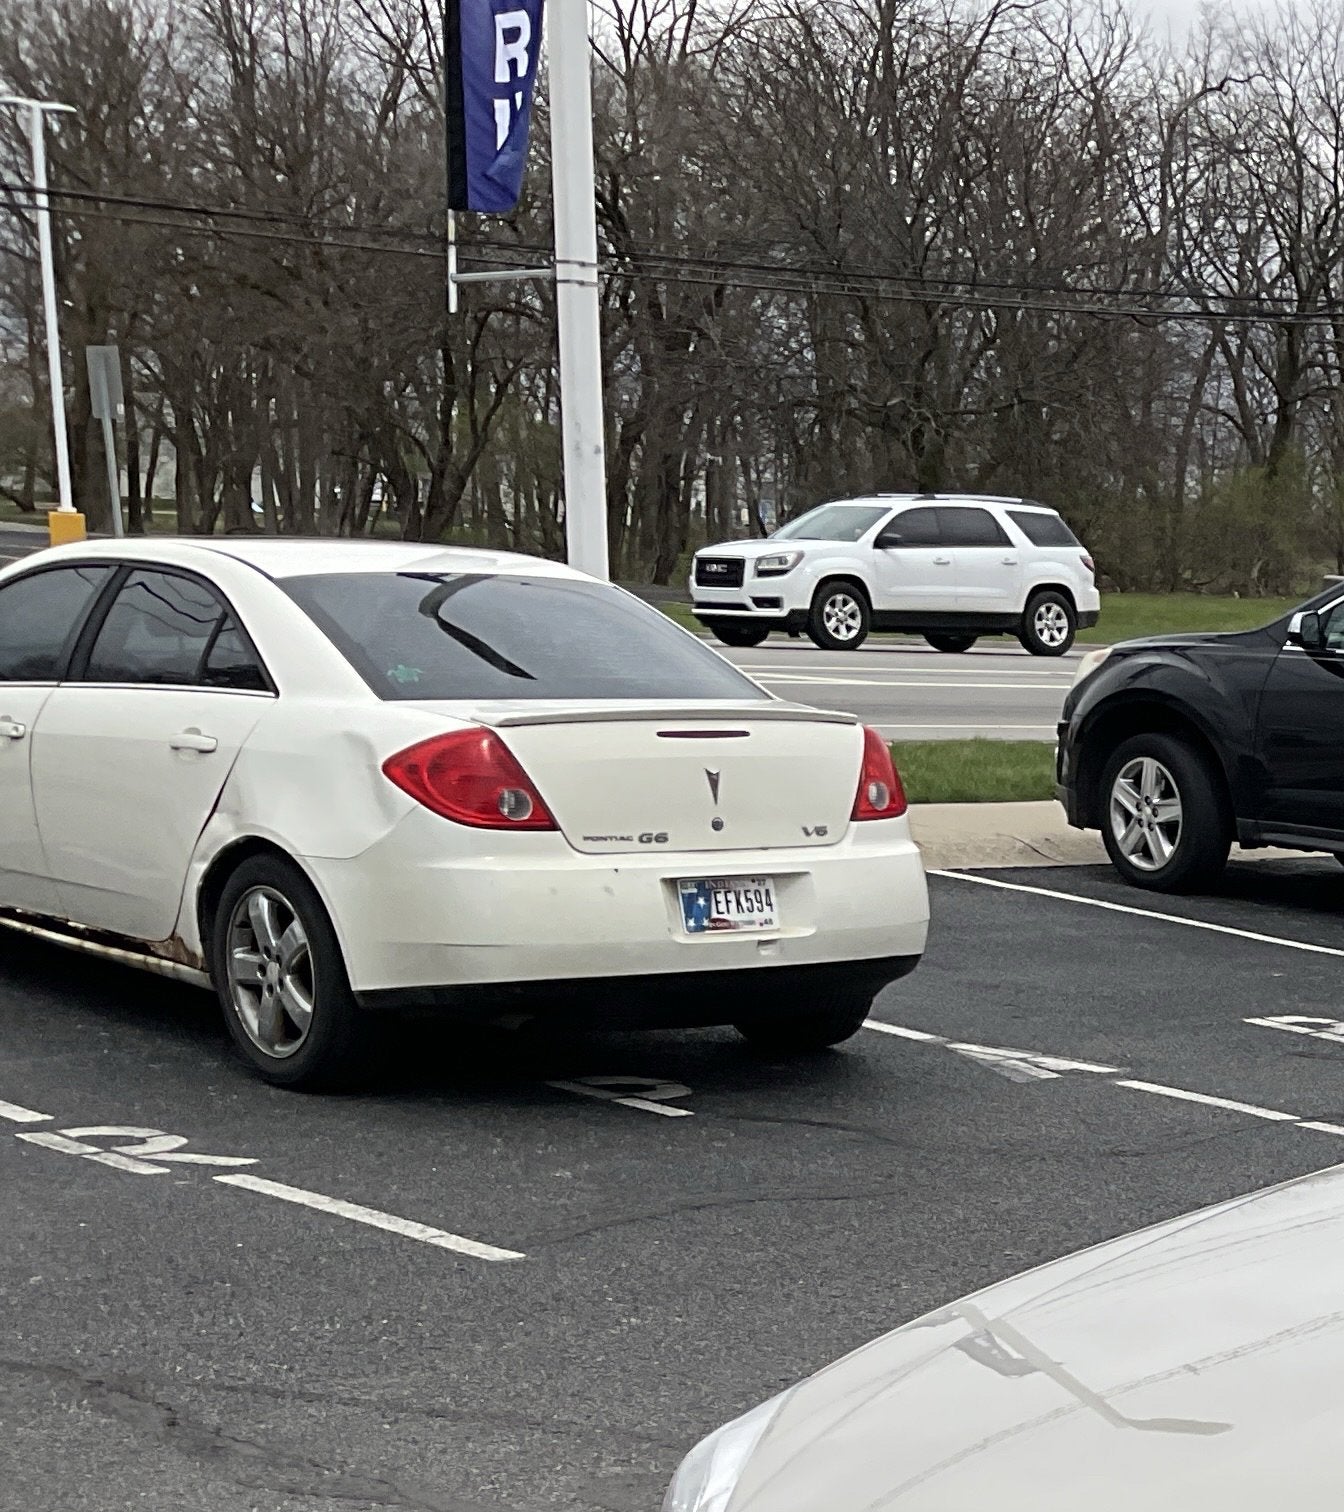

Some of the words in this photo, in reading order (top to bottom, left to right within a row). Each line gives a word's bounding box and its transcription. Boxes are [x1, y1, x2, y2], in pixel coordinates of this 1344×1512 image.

[638, 832, 669, 844] G6
[801, 825, 829, 838] V6
[713, 889, 773, 914] EFK594
